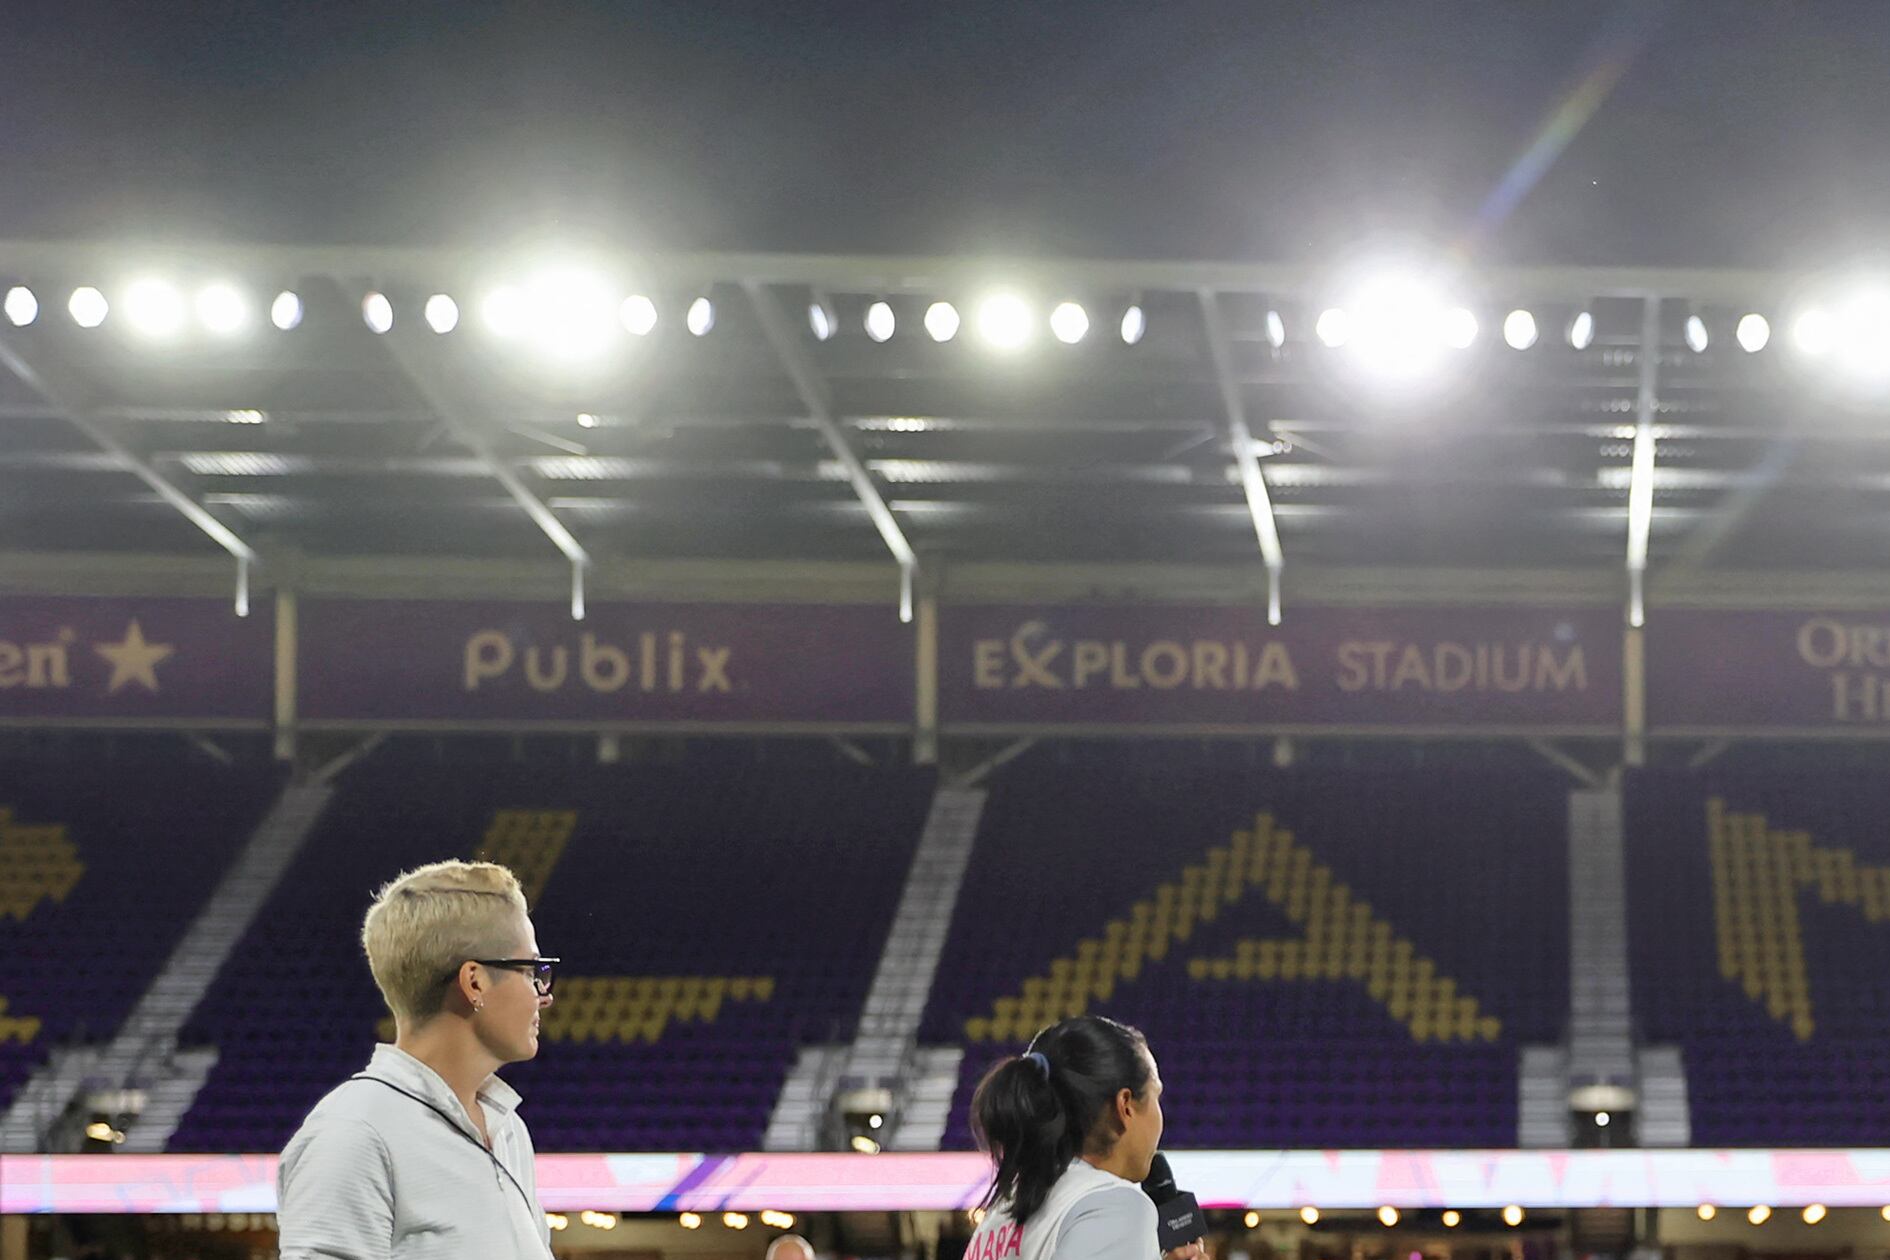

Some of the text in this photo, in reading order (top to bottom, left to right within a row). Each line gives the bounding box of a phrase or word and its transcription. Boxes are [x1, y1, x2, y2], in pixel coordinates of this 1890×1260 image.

[464, 630, 731, 692] Publix
[973, 621, 1589, 692] EXPLORIA STADIUM
